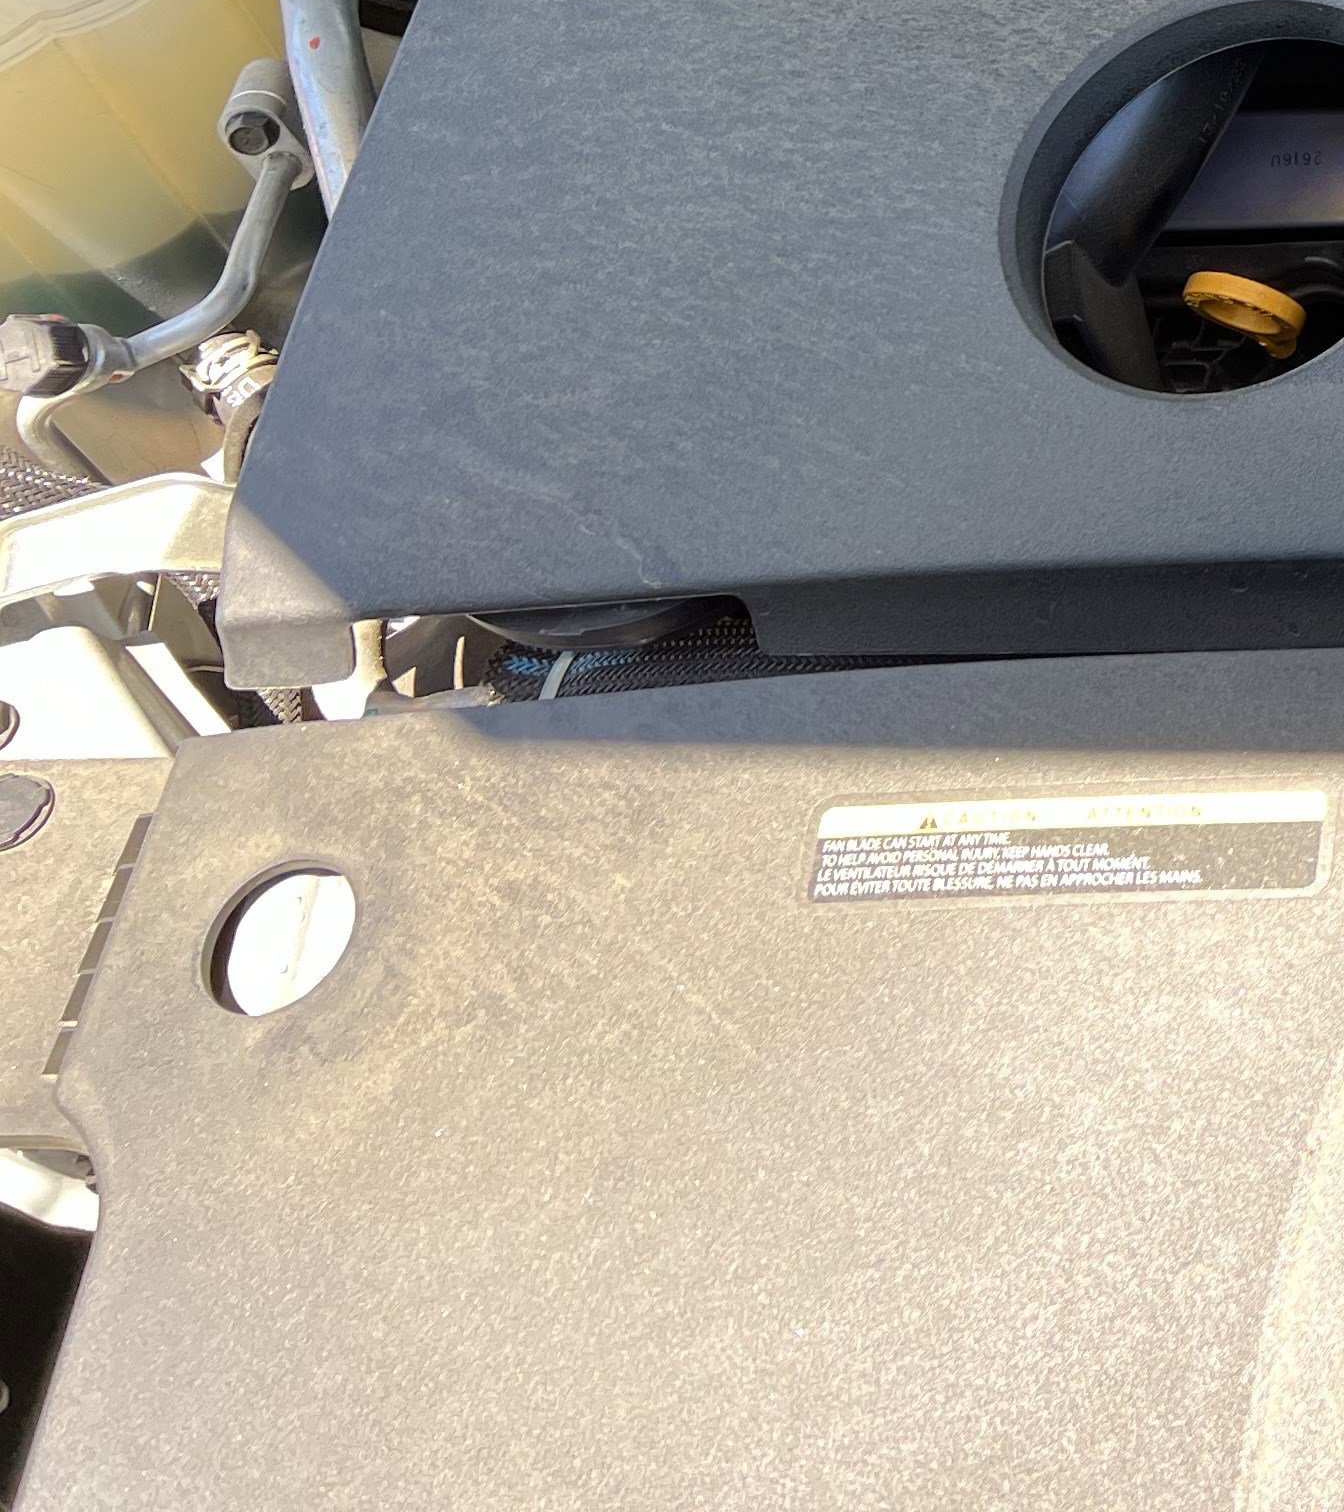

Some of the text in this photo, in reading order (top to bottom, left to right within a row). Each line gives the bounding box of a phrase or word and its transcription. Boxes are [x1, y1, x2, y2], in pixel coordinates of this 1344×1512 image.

[822, 832, 1012, 852] FAN BLADE CAN START AT ANY TIME.
[822, 854, 838, 867] TO
[838, 852, 867, 866] HELP
[866, 851, 902, 865] AVOID
[903, 849, 959, 863] PERSONAL
[961, 847, 1001, 862] INJURY,
[1001, 845, 1030, 859] KEEP
[1030, 844, 1072, 858] HANDS
[817, 868, 833, 882] LE
[833, 865, 912, 881] VENTILATEUR
[912, 863, 958, 877] RISQUE
[958, 862, 977, 875] DE
[1056, 858, 1092, 872] TOUT
[814, 882, 849, 897] POUR
[892, 878, 931, 893] TOUTE
[996, 874, 1014, 888] NE
[1015, 873, 1039, 888] PAS
[1039, 873, 1058, 887] EN
[1059, 871, 1134, 886] APPROCHER
[1135, 871, 1158, 885] LES
[1158, 869, 1203, 884] MAINS.
